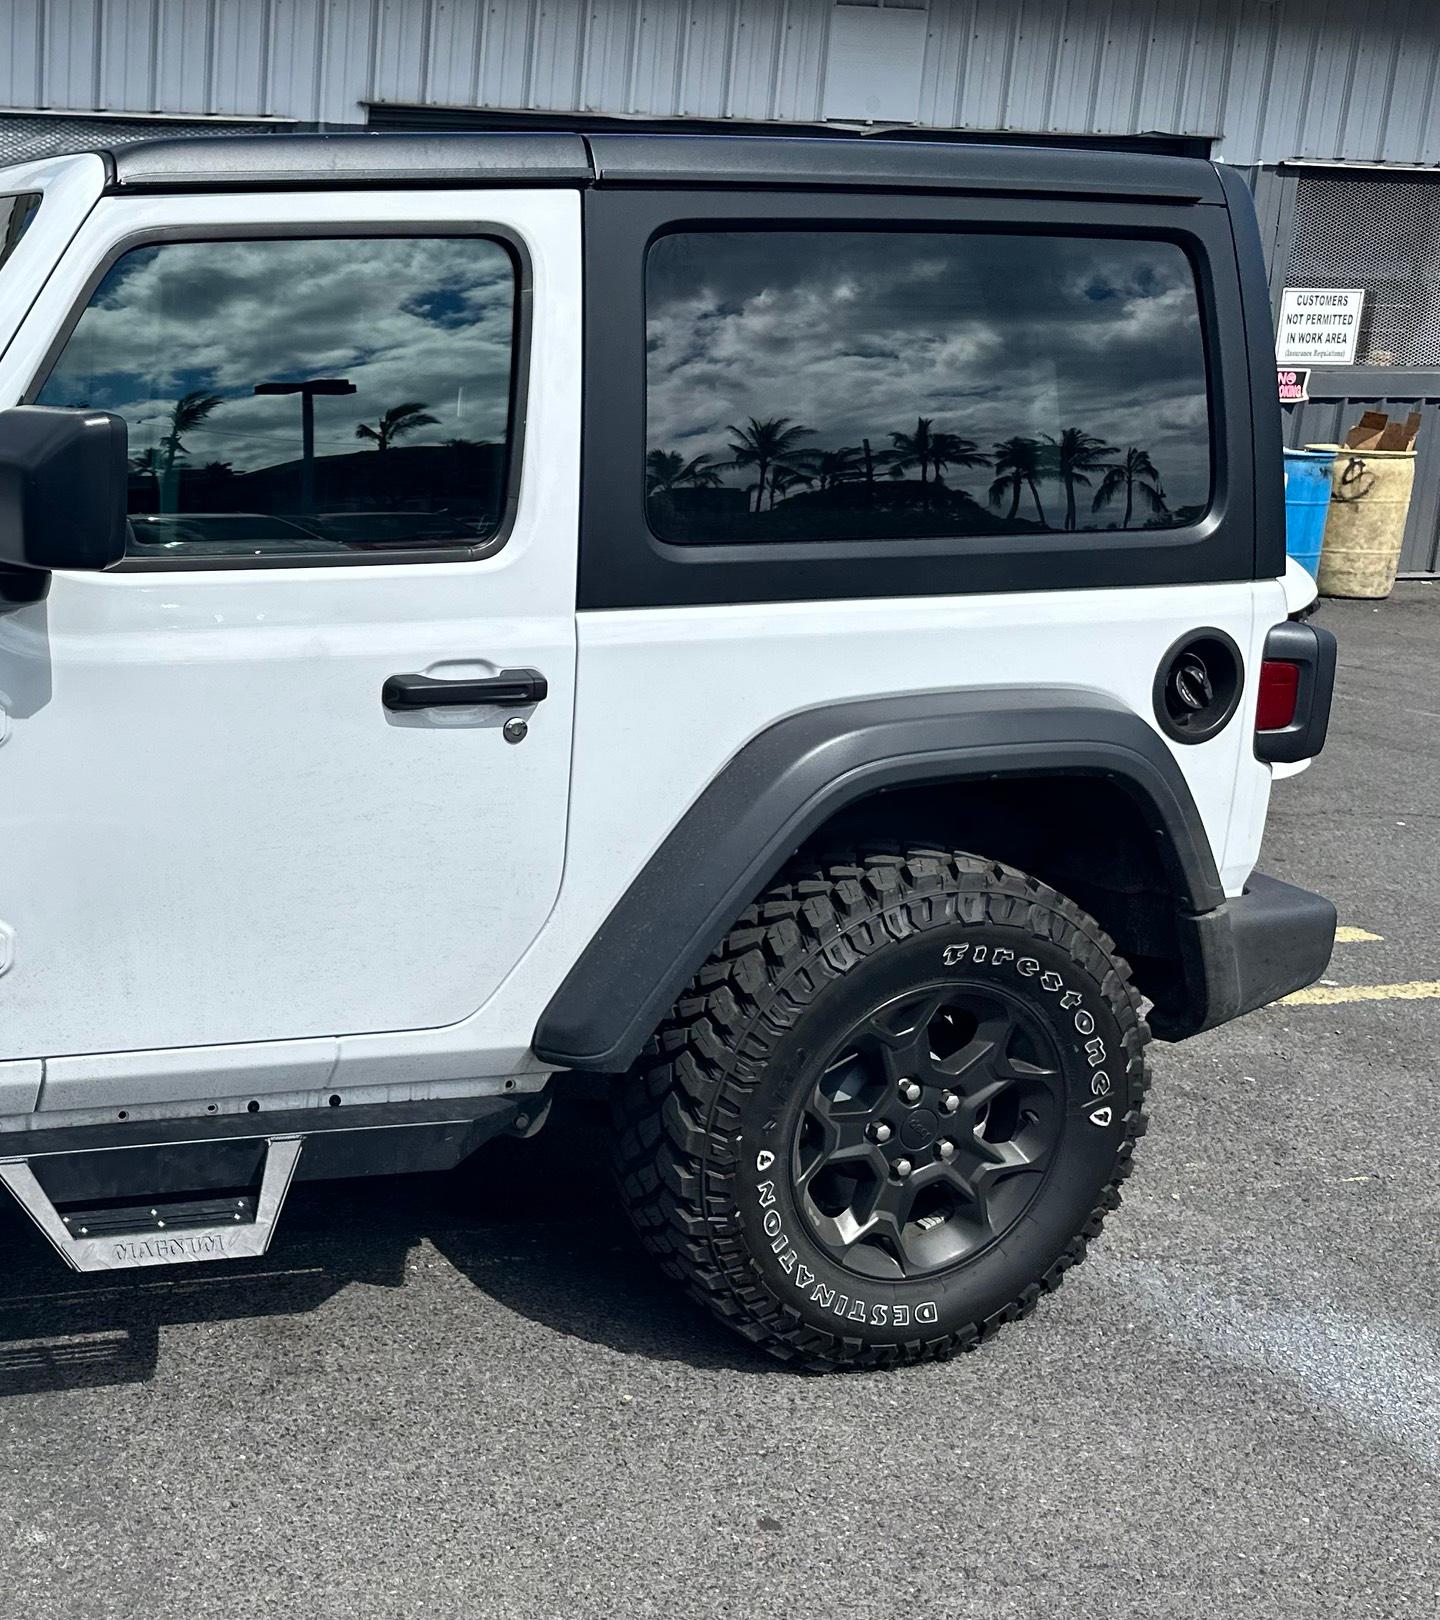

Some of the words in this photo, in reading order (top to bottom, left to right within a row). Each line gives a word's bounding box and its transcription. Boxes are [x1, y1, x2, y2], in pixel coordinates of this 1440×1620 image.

[1296, 295, 1349, 307] CUSTOMERS
[1286, 314, 1304, 326] NOT
[1305, 314, 1354, 326] PERMITTED
[1286, 333, 1296, 344] IN
[1298, 333, 1323, 344] WORK
[1324, 333, 1347, 345] AREA
[1277, 372, 1297, 385] NO
[942, 942, 1111, 1095] Firestone
[113, 1234, 225, 1260] MAGNUM
[756, 1180, 938, 1326] DESTINATION
